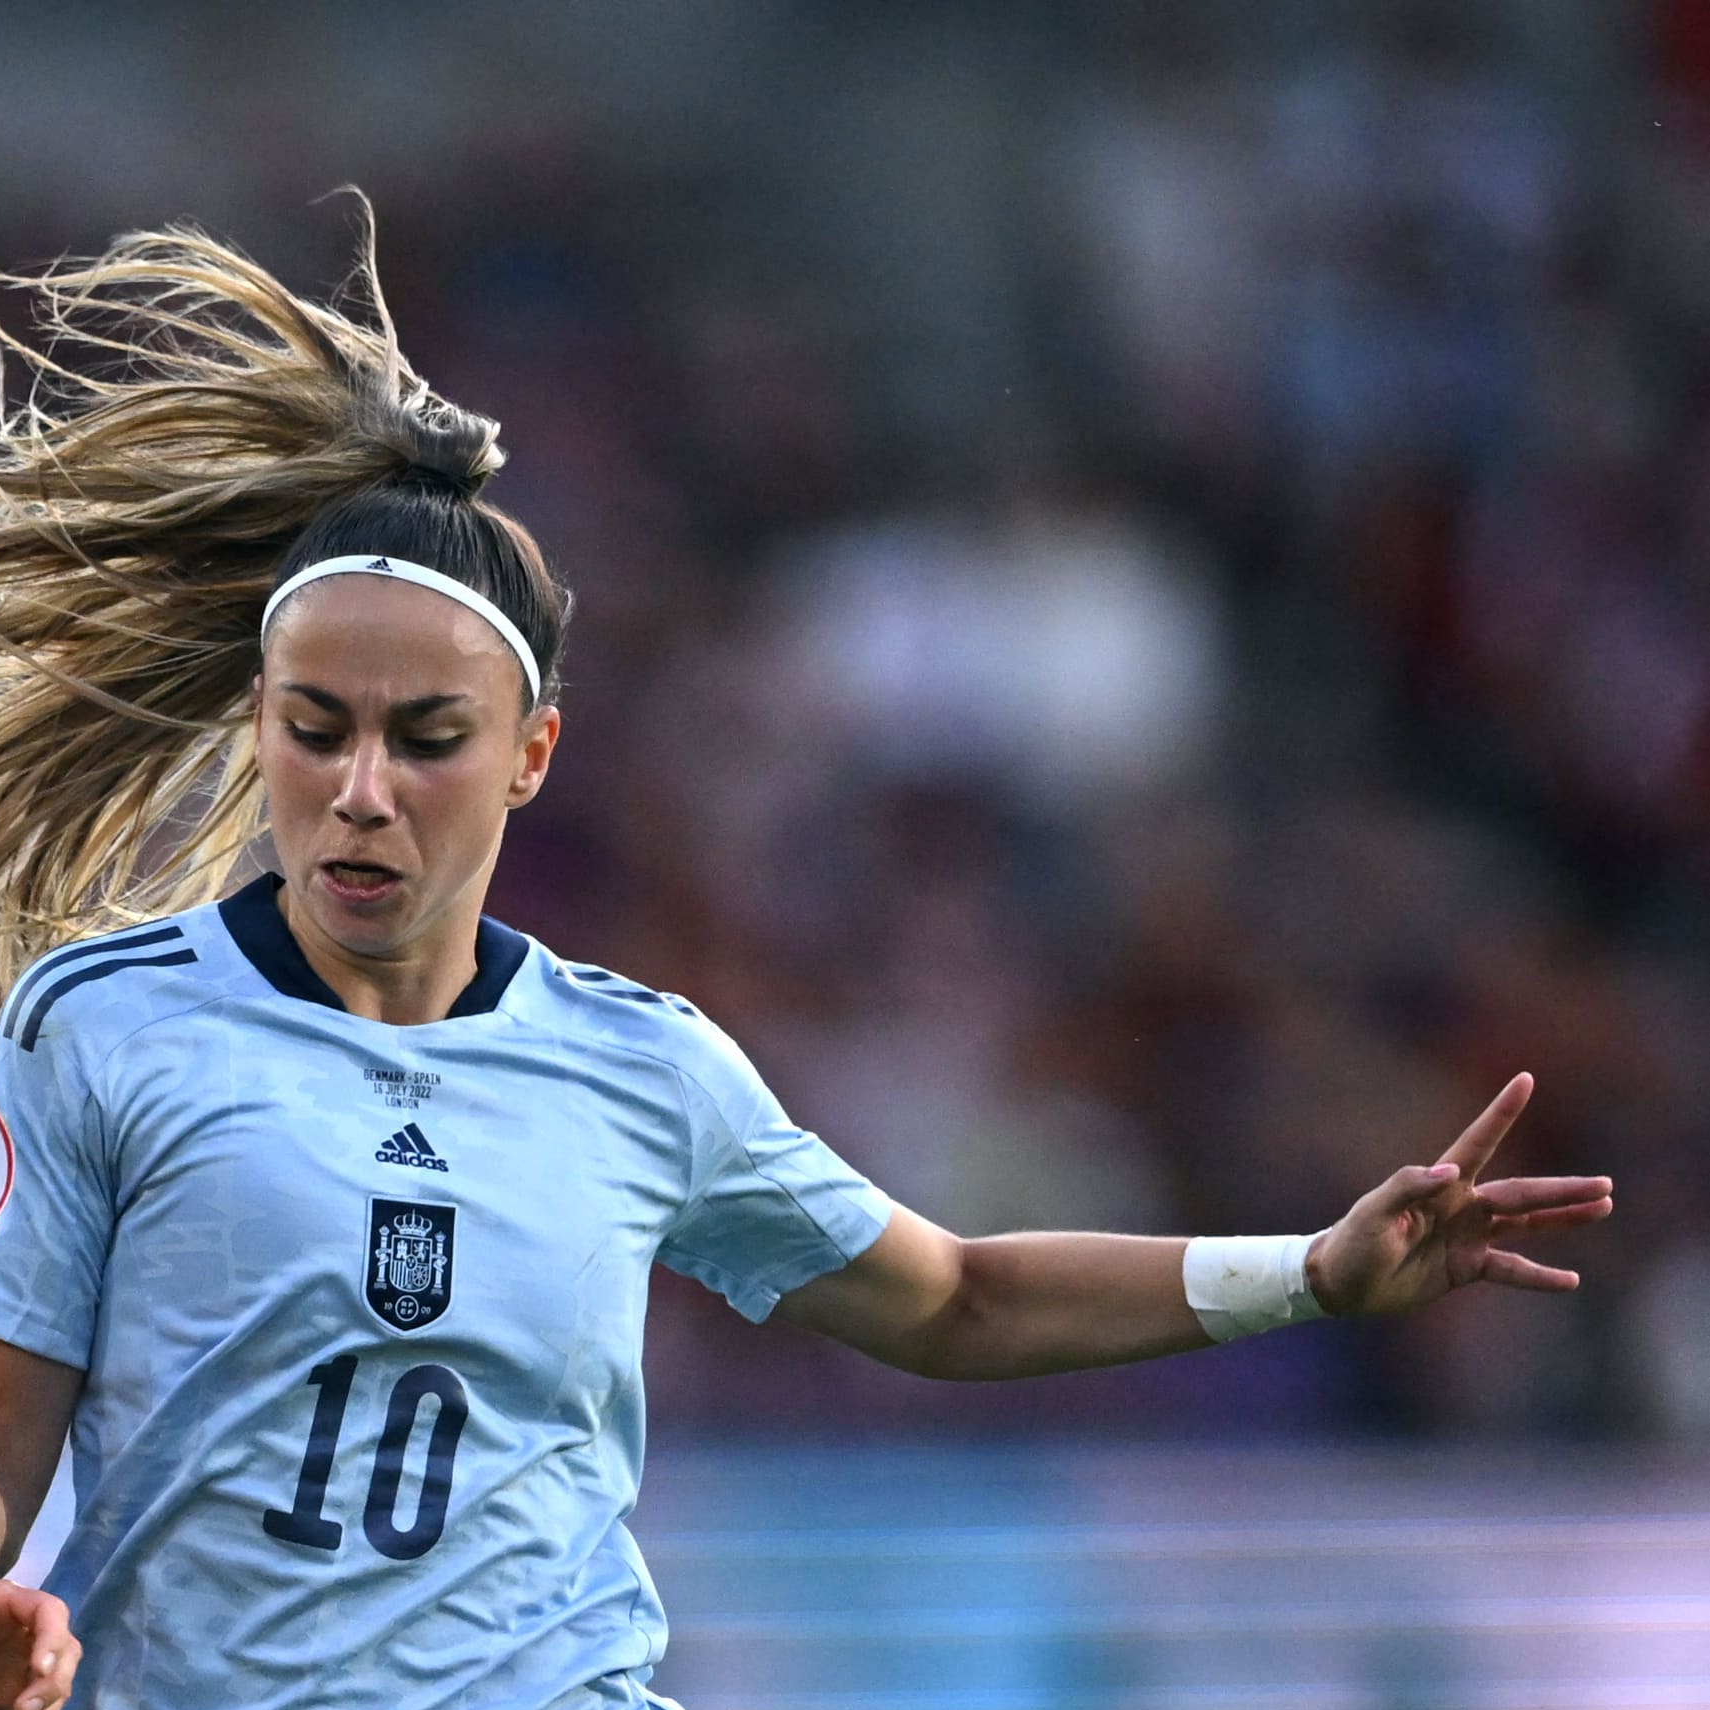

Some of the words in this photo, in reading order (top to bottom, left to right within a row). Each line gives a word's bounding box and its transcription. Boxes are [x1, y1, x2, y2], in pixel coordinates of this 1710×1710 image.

[364, 1069, 406, 1083] DENMARK
[413, 1072, 441, 1085] SPAIN
[386, 1084, 406, 1096] JULY
[410, 1086, 432, 1098] 2022
[375, 1150, 449, 1172] adidas
[263, 1354, 469, 1561] 10
